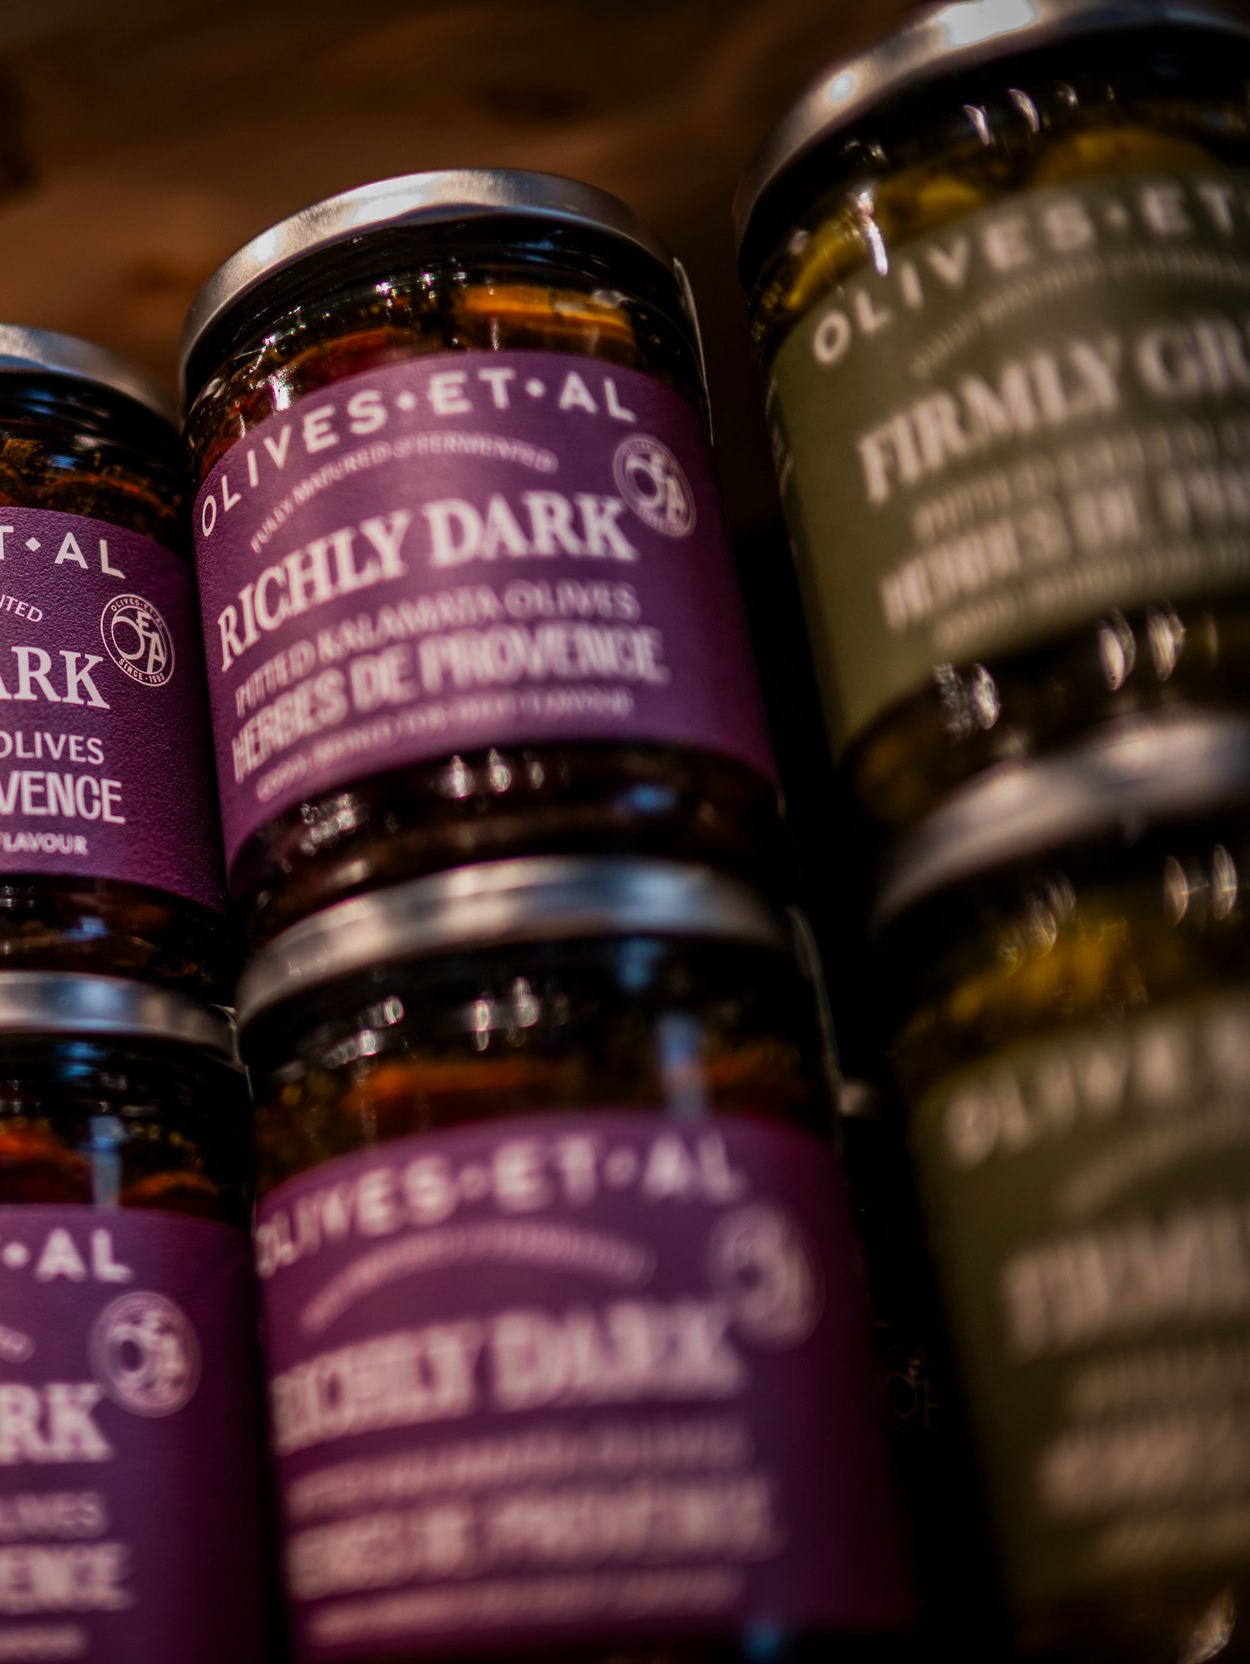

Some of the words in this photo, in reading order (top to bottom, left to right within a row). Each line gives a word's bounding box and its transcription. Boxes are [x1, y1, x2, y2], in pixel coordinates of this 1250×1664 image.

[202, 390, 389, 537] OLIVES
[427, 368, 517, 416] ET
[559, 372, 638, 423] AL
[54, 532, 126, 579] AL
[217, 509, 412, 672] RICHLY
[424, 489, 640, 568] DARK
[118, 658, 143, 681] SINCE
[350, 643, 419, 713] DE
[419, 621, 672, 694] PROVENCE
[36, 1227, 133, 1283] AL
